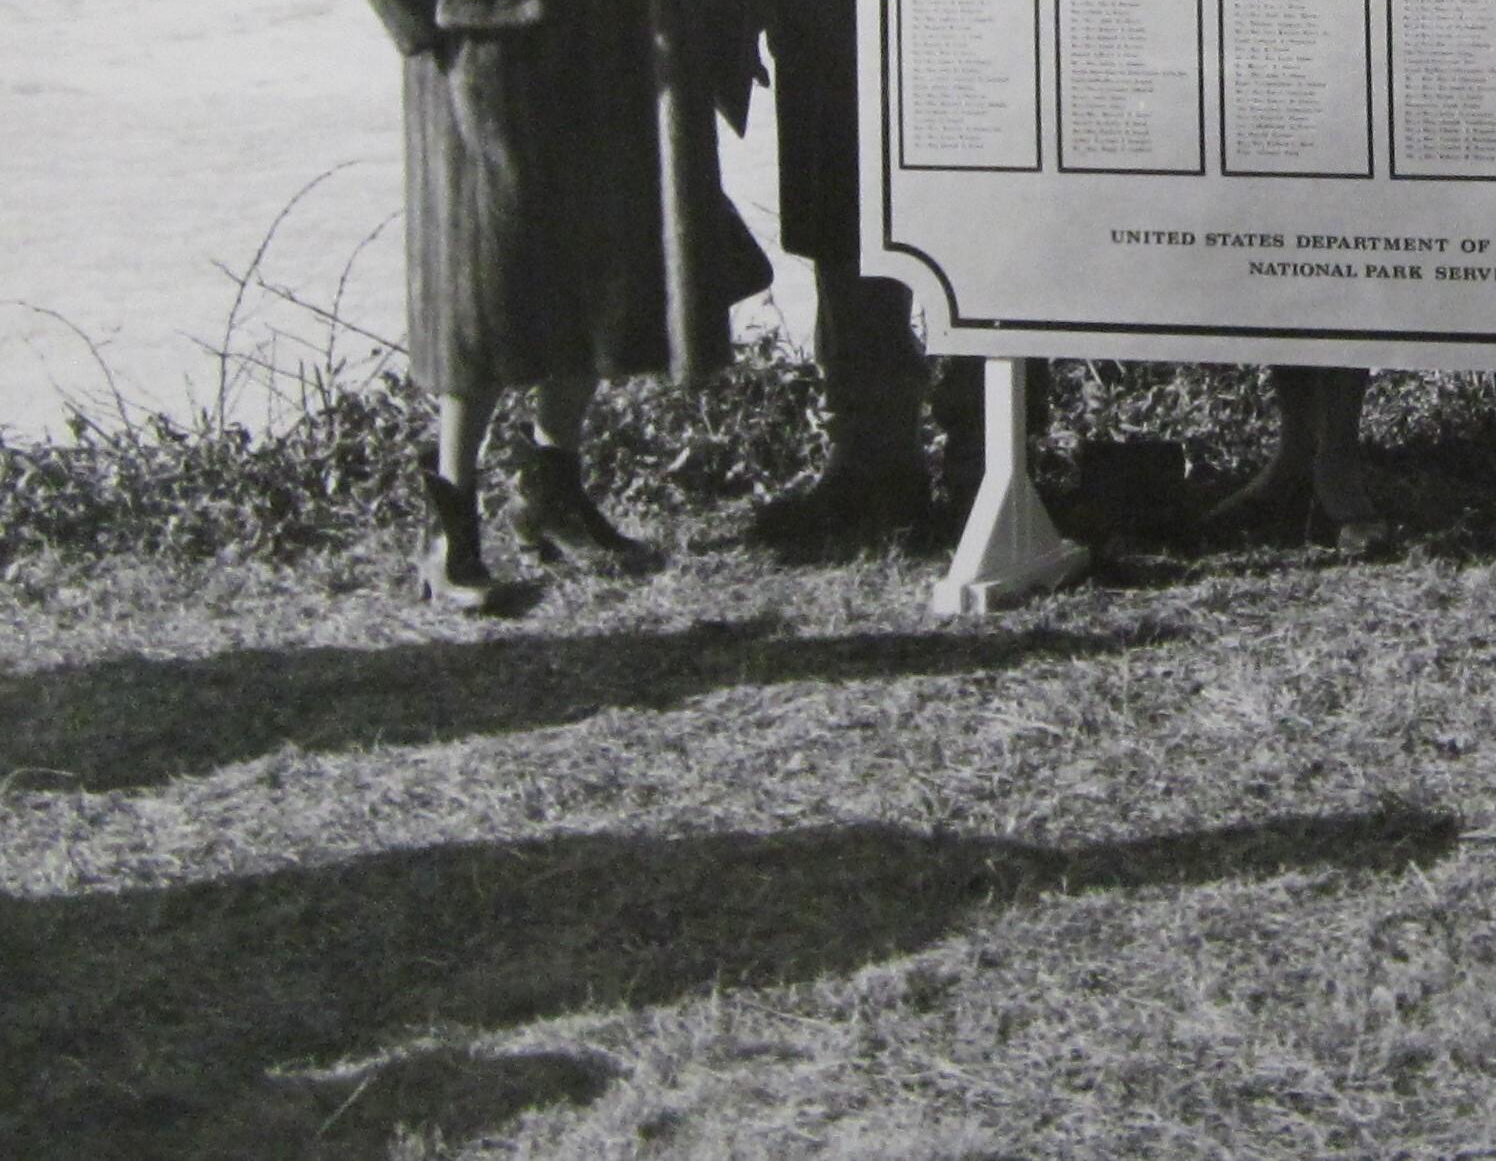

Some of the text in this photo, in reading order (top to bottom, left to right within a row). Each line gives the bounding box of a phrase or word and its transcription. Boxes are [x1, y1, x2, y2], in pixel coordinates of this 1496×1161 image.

[1110, 229, 1196, 246] UNITED
[1204, 232, 1285, 249] STATES
[1295, 234, 1450, 253] DEPARTMENT
[1460, 238, 1491, 254] OF
[1248, 261, 1359, 279] NATIONAL
[1364, 263, 1423, 280] PARK
